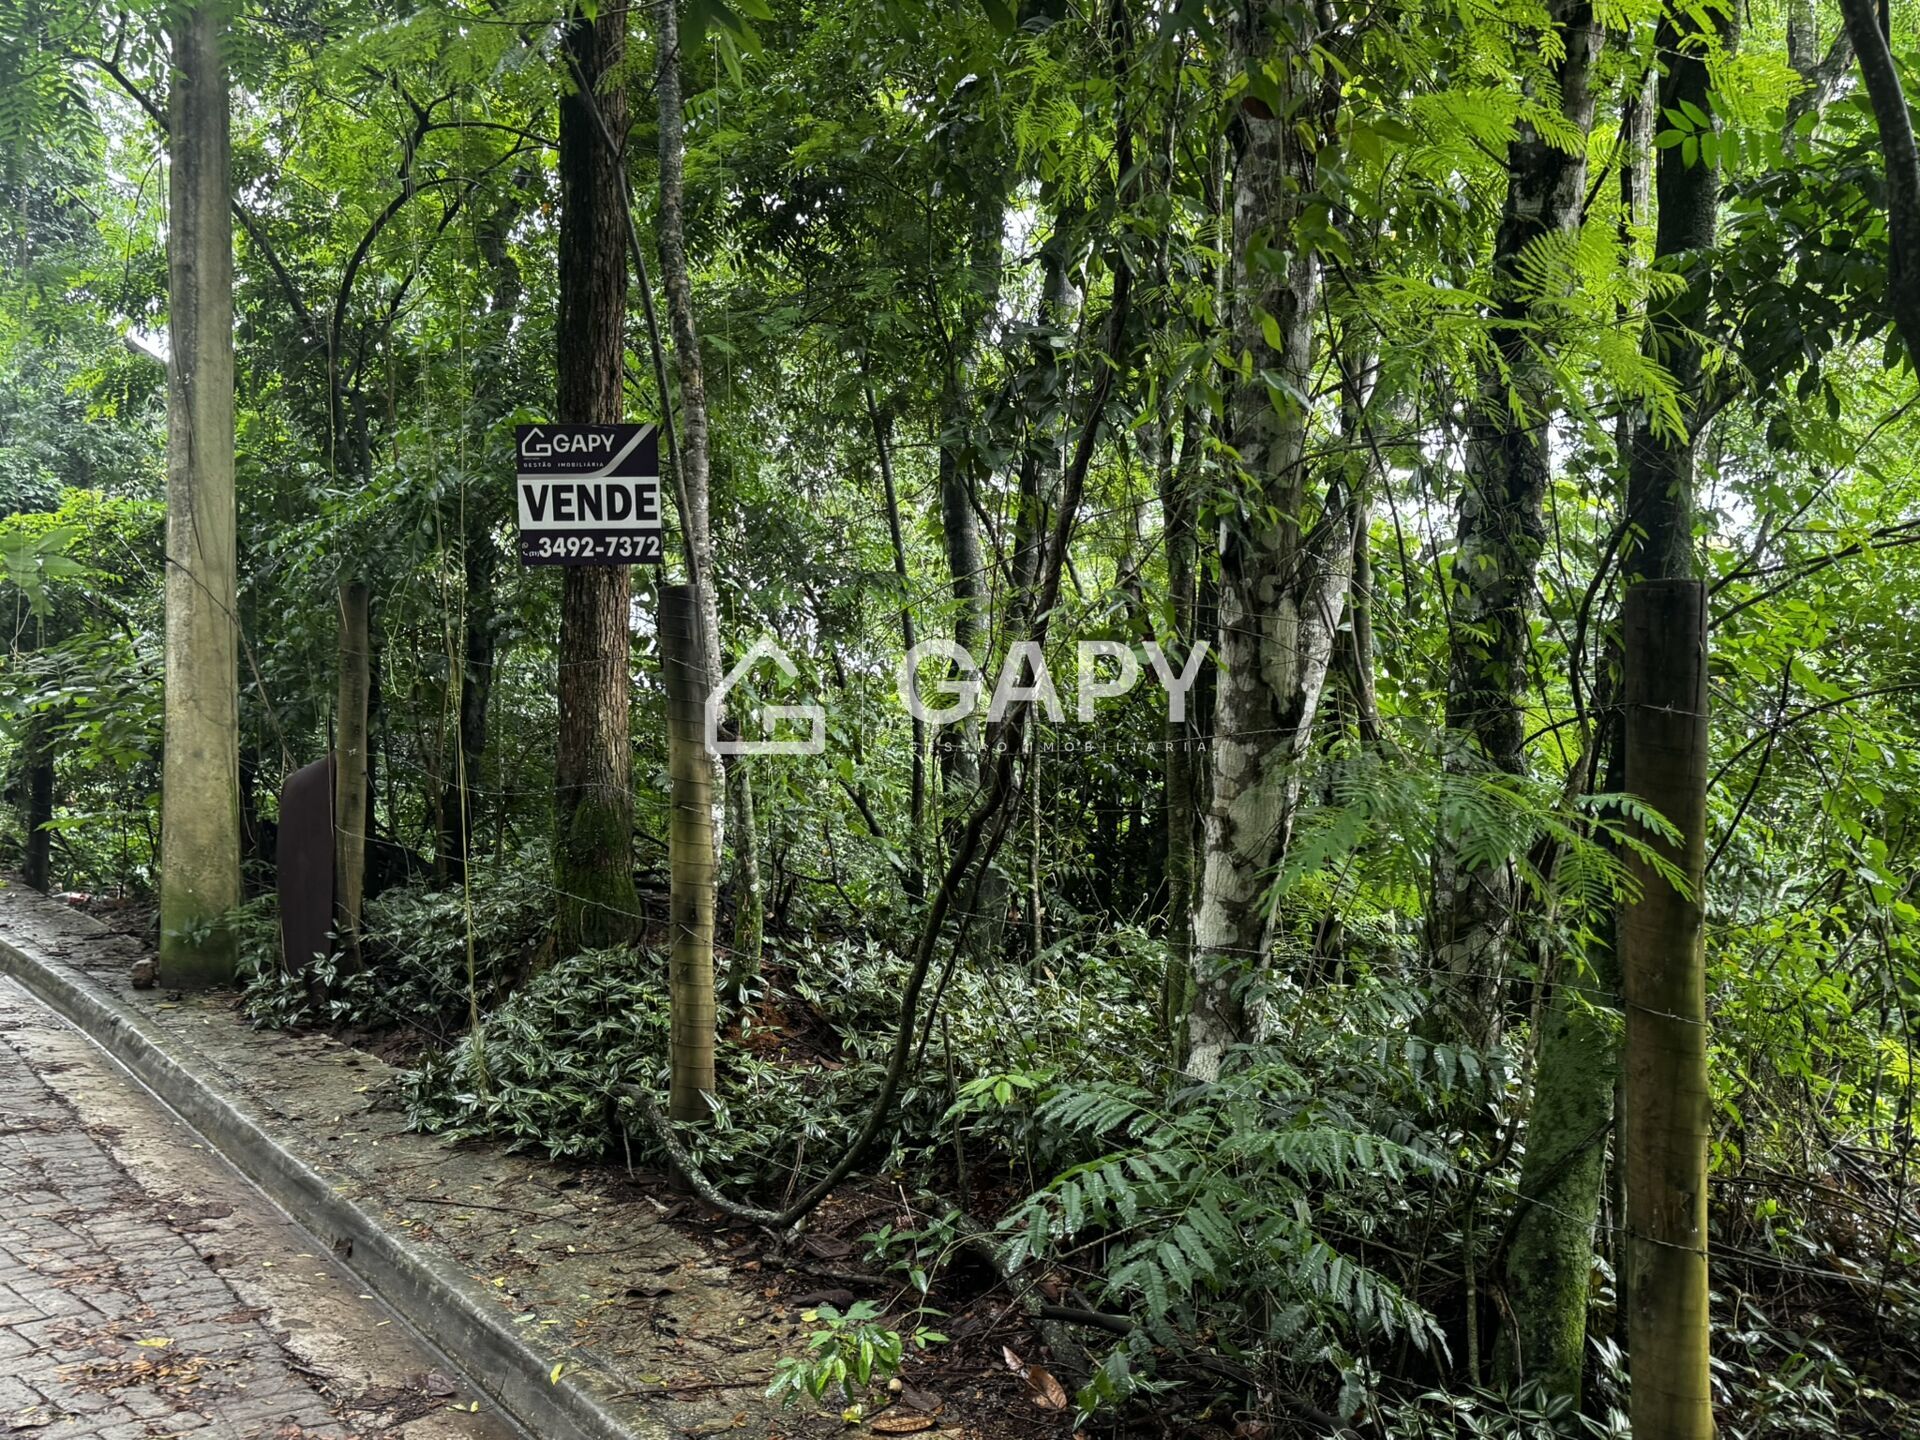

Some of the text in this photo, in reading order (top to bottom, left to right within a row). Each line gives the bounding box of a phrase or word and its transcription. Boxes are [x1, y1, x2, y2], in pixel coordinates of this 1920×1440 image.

[552, 434, 615, 453] GAPY
[522, 484, 658, 522] VENDE
[538, 536, 660, 558] 3492-7372
